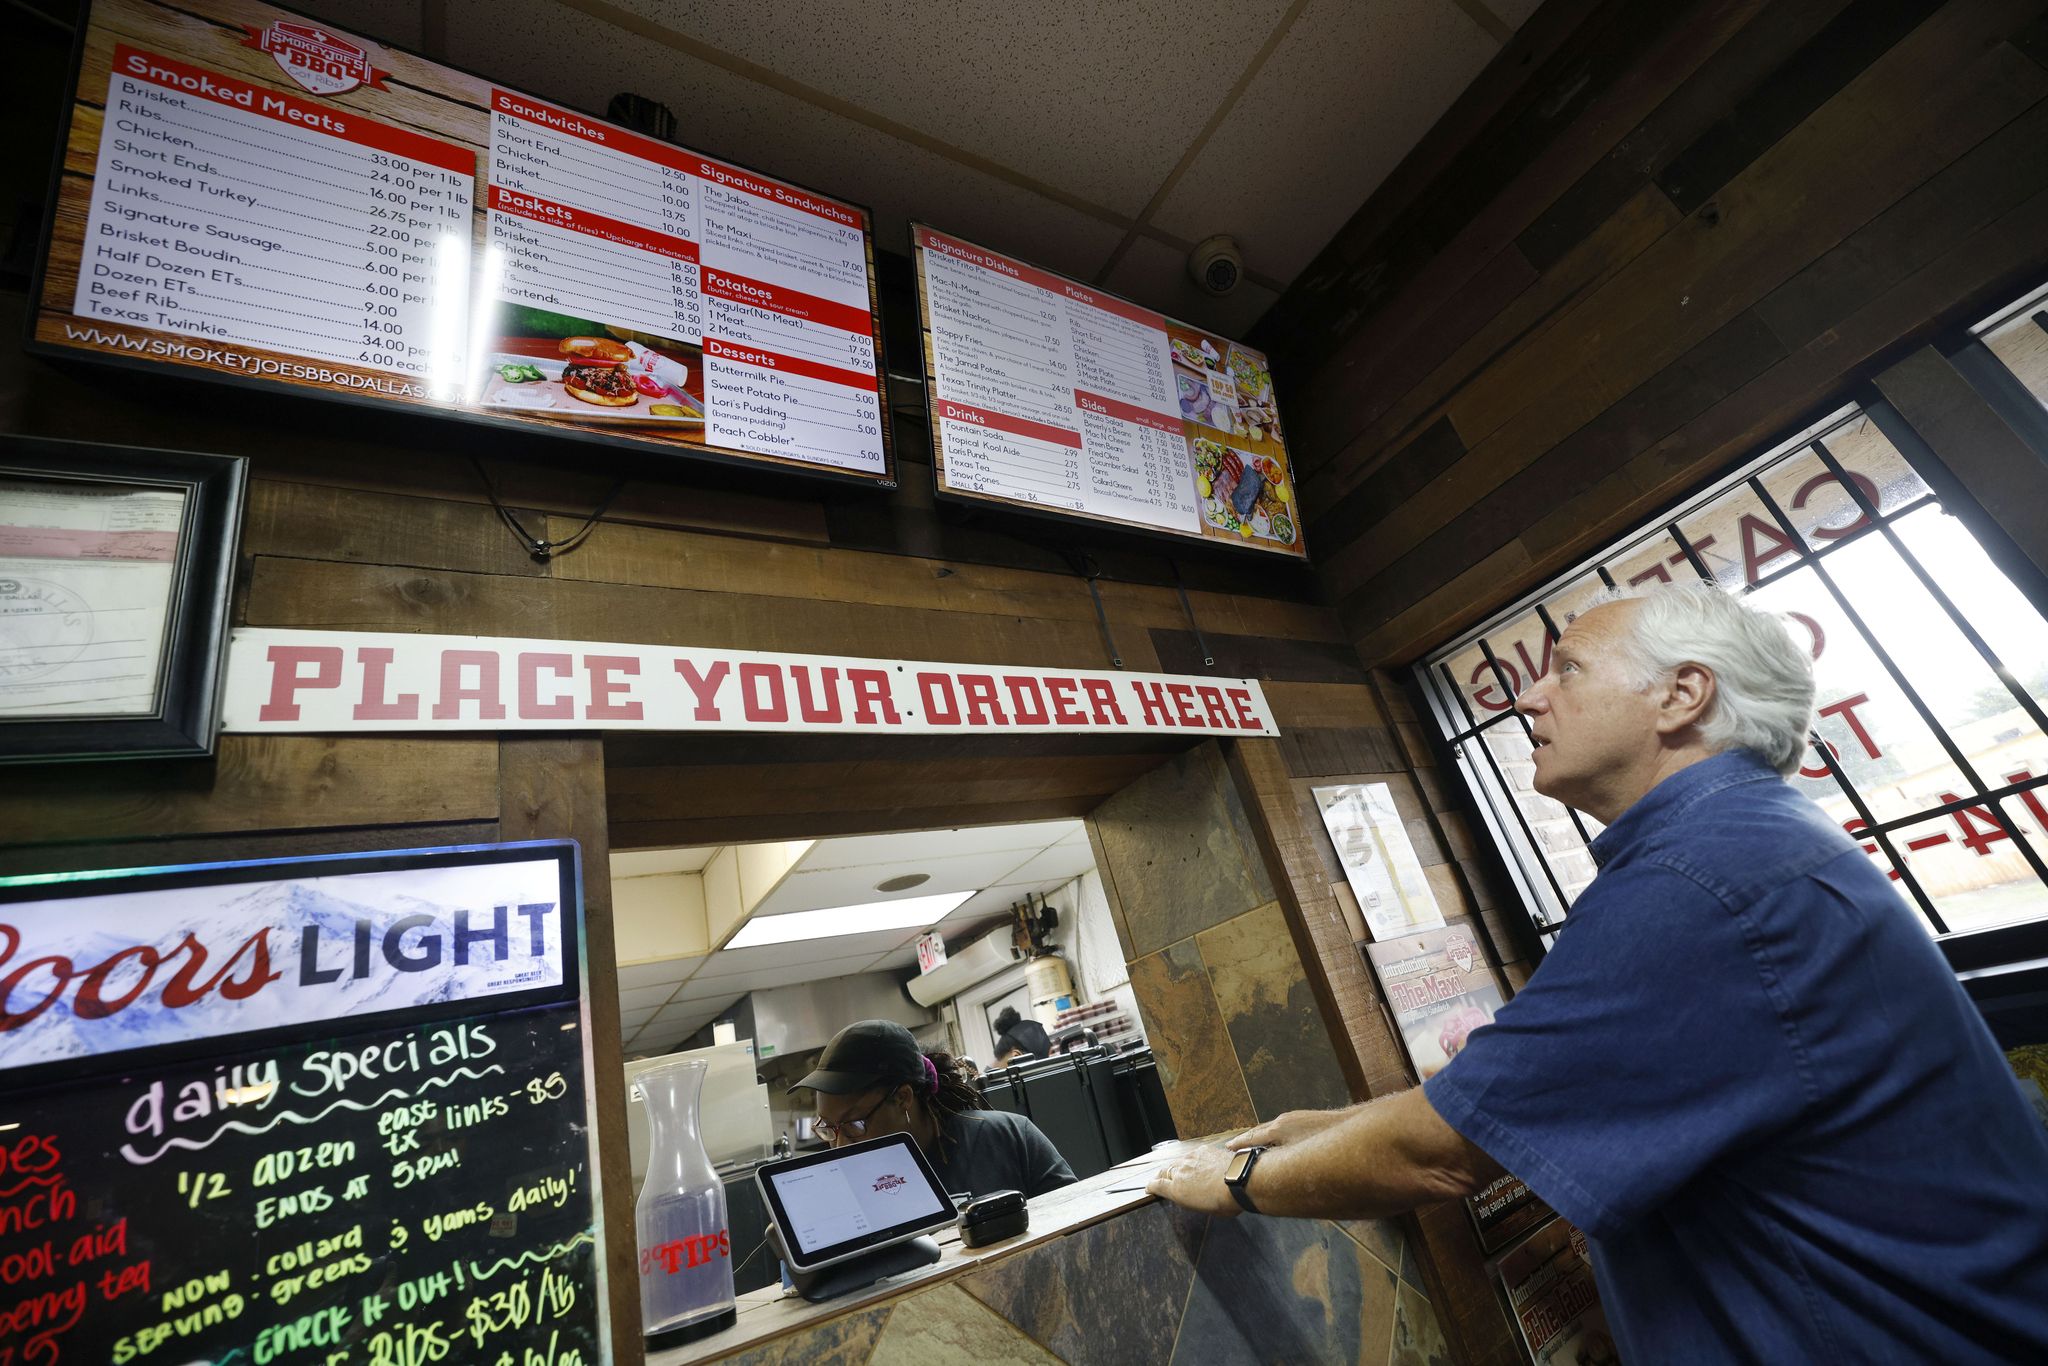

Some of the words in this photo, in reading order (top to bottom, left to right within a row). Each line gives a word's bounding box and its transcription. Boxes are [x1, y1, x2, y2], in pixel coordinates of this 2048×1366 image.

[289, 47, 343, 80] BBQ
[127, 55, 253, 106] Smoked
[262, 96, 346, 134] Meats
[122, 81, 188, 110] Brisket
[370, 153, 409, 172] 33.00
[498, 96, 606, 141] Sandwiches
[116, 120, 195, 149] Chicken
[370, 188, 406, 204] 16.00
[119, 100, 162, 121] Ribs
[370, 170, 415, 190] 24.00
[498, 114, 520, 128] Rib
[661, 167, 686, 182] 12.50
[498, 130, 533, 146] Short
[536, 141, 560, 156] End
[662, 182, 689, 196] 14.00
[114, 139, 167, 162] Short
[173, 154, 218, 175] Ends
[370, 206, 406, 224] 26.75
[496, 158, 541, 180] Brisket
[662, 208, 686, 222] 13.75
[497, 144, 549, 167] Chicken
[662, 194, 690, 210] 10.00
[700, 164, 772, 196] Signature
[776, 189, 854, 224] Sandwiches
[704, 185, 722, 198] The
[724, 192, 750, 207] Jabo
[106, 180, 160, 202] Links
[366, 242, 398, 258] 5.00
[110, 160, 192, 189] Smoked
[198, 180, 257, 207] Turkey
[370, 224, 410, 242] 22.00
[494, 214, 523, 230] Ribs
[496, 174, 524, 190] Link
[662, 222, 690, 238] 10.00
[498, 189, 573, 220] Baskets
[104, 200, 200, 232] Signature
[205, 224, 282, 252] Sausage
[365, 261, 398, 277] 6.00
[494, 226, 540, 247] Brisket
[705, 218, 724, 230] The
[726, 225, 752, 240] Maxi
[100, 223, 169, 249] Brisket
[174, 240, 241, 265] Boudin
[365, 282, 398, 298] 6.00
[659, 247, 695, 262] shortends
[929, 236, 983, 263] Signature
[985, 256, 1019, 276] Dishes
[94, 264, 158, 288] Dozen
[163, 278, 196, 295] ETs
[363, 318, 402, 335] 14.00
[96, 245, 141, 264] Half
[145, 256, 205, 278] Dozen
[211, 270, 242, 287] ETs
[364, 302, 397, 317] 9.00
[708, 273, 772, 300] Potatoes
[931, 274, 980, 296] Mac-N-Meat
[1066, 286, 1094, 303] Plates
[89, 300, 149, 322] Texas
[156, 313, 228, 336] Twinkie
[359, 352, 393, 366] 6.00
[90, 282, 141, 301] Beef
[145, 293, 180, 309] Rib
[362, 334, 404, 352] 34.00
[671, 323, 702, 338] 20.00
[716, 312, 744, 326] Meat
[849, 345, 871, 357] 17.50
[773, 314, 803, 329] Meat)
[850, 334, 871, 346] 6.00
[934, 300, 960, 315] Brisket
[962, 309, 991, 325] Nachos
[710, 342, 776, 367] Desserts
[718, 324, 752, 341] Meats
[850, 357, 874, 370] 19.50
[936, 326, 963, 343] Sloppy
[965, 335, 982, 346] Fries
[710, 362, 767, 382] Buttermilk
[770, 374, 785, 386] Pie
[855, 394, 874, 404] 5.00
[711, 380, 744, 394] Sweet
[746, 386, 780, 401] Potato
[784, 394, 798, 405] Pie
[856, 409, 876, 420] 5.00
[941, 374, 966, 387] Texas
[966, 380, 990, 394] Trinity
[992, 387, 1016, 400] Platter
[743, 402, 787, 420] Pudding
[858, 424, 877, 436] 5.00
[947, 406, 985, 424] Drinks
[1081, 398, 1107, 414] Sides
[713, 424, 746, 438] Peach
[860, 450, 880, 461] 5.00
[946, 421, 982, 436] Fountain
[982, 430, 1004, 441] Soda
[948, 434, 979, 448] Tropical
[983, 442, 1002, 453] Kool
[876, 480, 897, 488] VIZIO
[950, 456, 974, 470] Texas
[950, 469, 972, 480] Snow
[259, 645, 644, 722] PLACE
[674, 658, 902, 724] YOUR
[916, 672, 1129, 726] ORDER
[1131, 681, 1263, 730] HERE
[299, 902, 557, 987] LIGHT
[1381, 958, 1432, 979] Introducing
[1390, 980, 1426, 1014] The
[1422, 968, 1467, 1004] Maxi
[126, 1059, 281, 1137] daily
[290, 1024, 497, 1097] specials
[178, 1171, 233, 1208] 1/2
[446, 1096, 509, 1130] links
[266, 1224, 362, 1276] collard
[423, 1202, 494, 1242] yams
[508, 1168, 576, 1212] daily!
[659, 1228, 730, 1274] TIPS
[270, 1253, 372, 1305] greens
[1521, 1304, 1560, 1350] The
